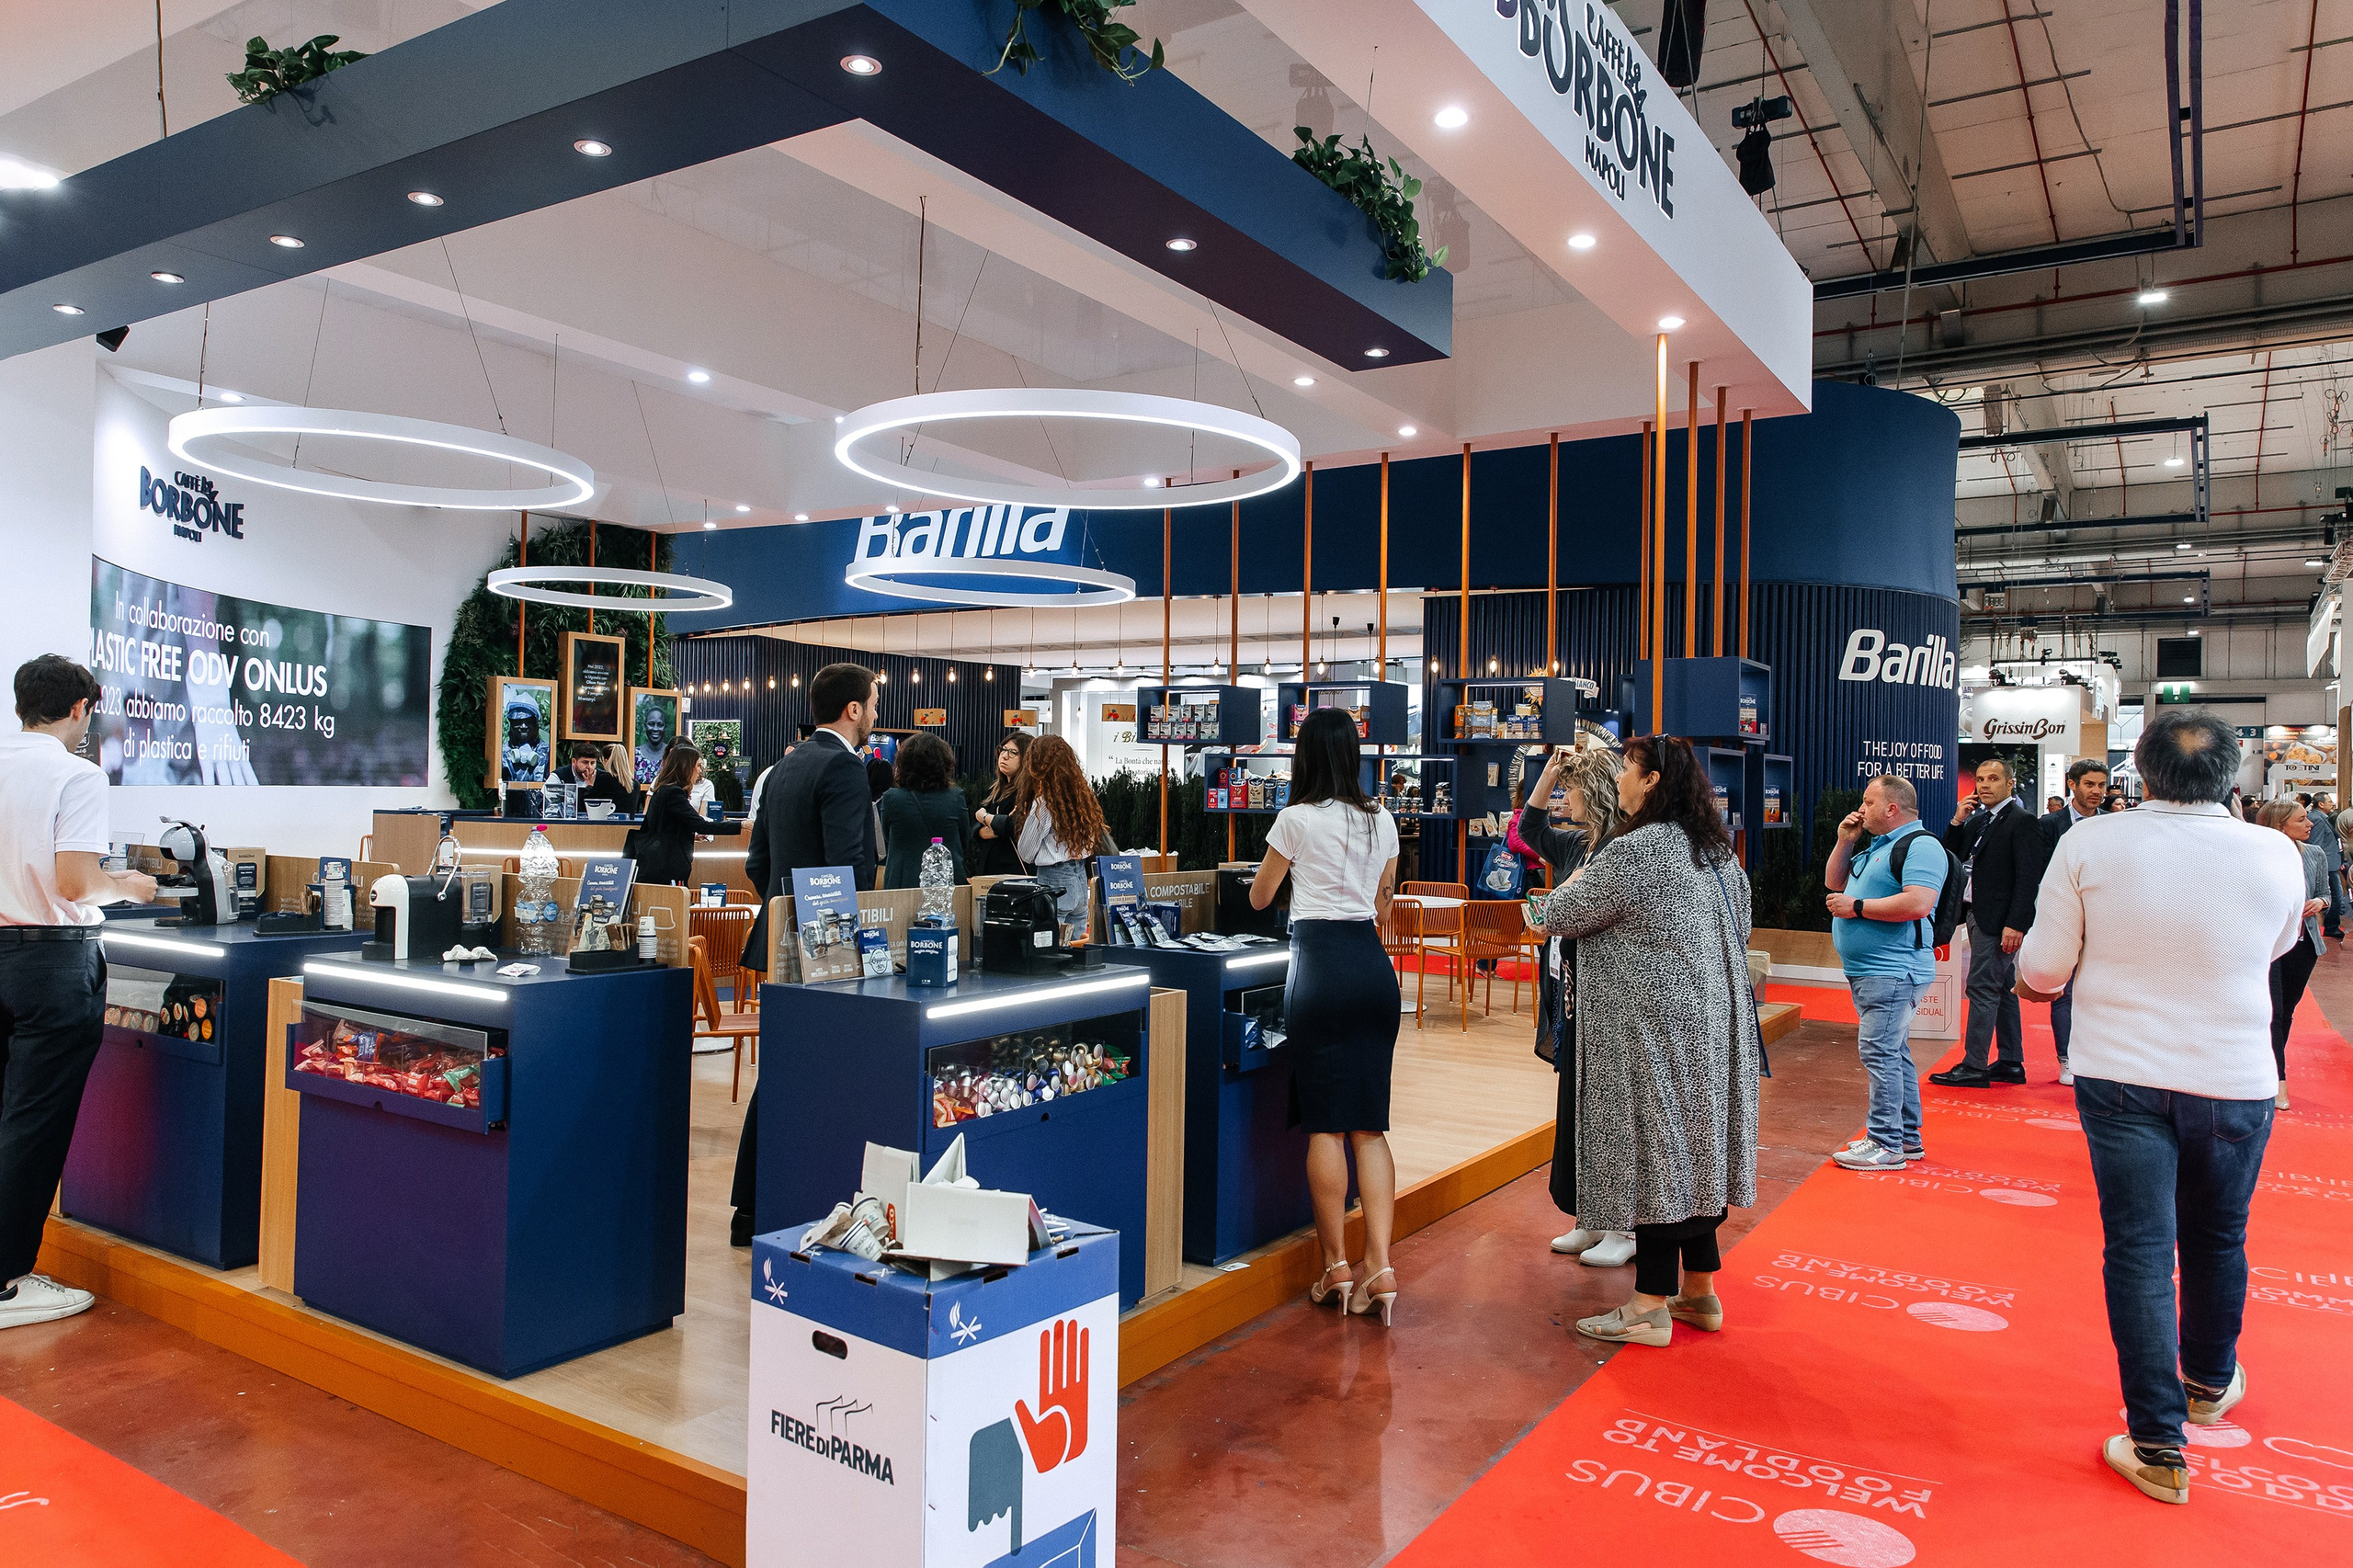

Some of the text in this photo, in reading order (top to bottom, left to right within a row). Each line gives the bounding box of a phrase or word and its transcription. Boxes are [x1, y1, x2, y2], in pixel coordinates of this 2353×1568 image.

[1584, 135, 1625, 200] NAPOLI
[140, 465, 244, 540] BORBONE
[115, 590, 269, 647] In collaborazione con
[91, 628, 328, 697] LASTIC FREE ODV ONLUS
[1838, 629, 1955, 689] Barilla
[126, 687, 186, 722] abbiamo
[192, 699, 253, 727] raccolto
[259, 703, 306, 731] 8423
[314, 705, 335, 739] kg
[1984, 718, 2065, 741] GrissinBon
[123, 727, 135, 759] di
[140, 729, 192, 767] plastica
[198, 743, 208, 760] e
[212, 734, 250, 762] rifiuti
[1863, 741, 1887, 756] THE
[1889, 742, 1909, 757] JOY
[2249, 727, 2256, 737] 3
[1123, 756, 1141, 765] Bontà
[1142, 756, 1154, 765] che
[1858, 761, 1943, 779] FOR A BETTER LIFE
[595, 865, 619, 875] BORBONE
[810, 876, 842, 886] BORBONE
[1150, 883, 1211, 898] COMPOSTABILE
[859, 907, 893, 924] TIBILI
[910, 941, 943, 949] BORBONE
[1915, 1008, 1945, 1017] SIDUAL
[1857, 1172, 1974, 1194] CIBUS
[1752, 1275, 1901, 1310] CIBUS
[1771, 1260, 2014, 1309] WELCOME TO
[770, 1409, 815, 1452] FIERE
[831, 1435, 894, 1486] PARMA
[1613, 1418, 1933, 1504] FOODLAND
[1564, 1459, 1766, 1524] CIBUS
[1602, 1429, 1927, 1519] WELCOME TO
